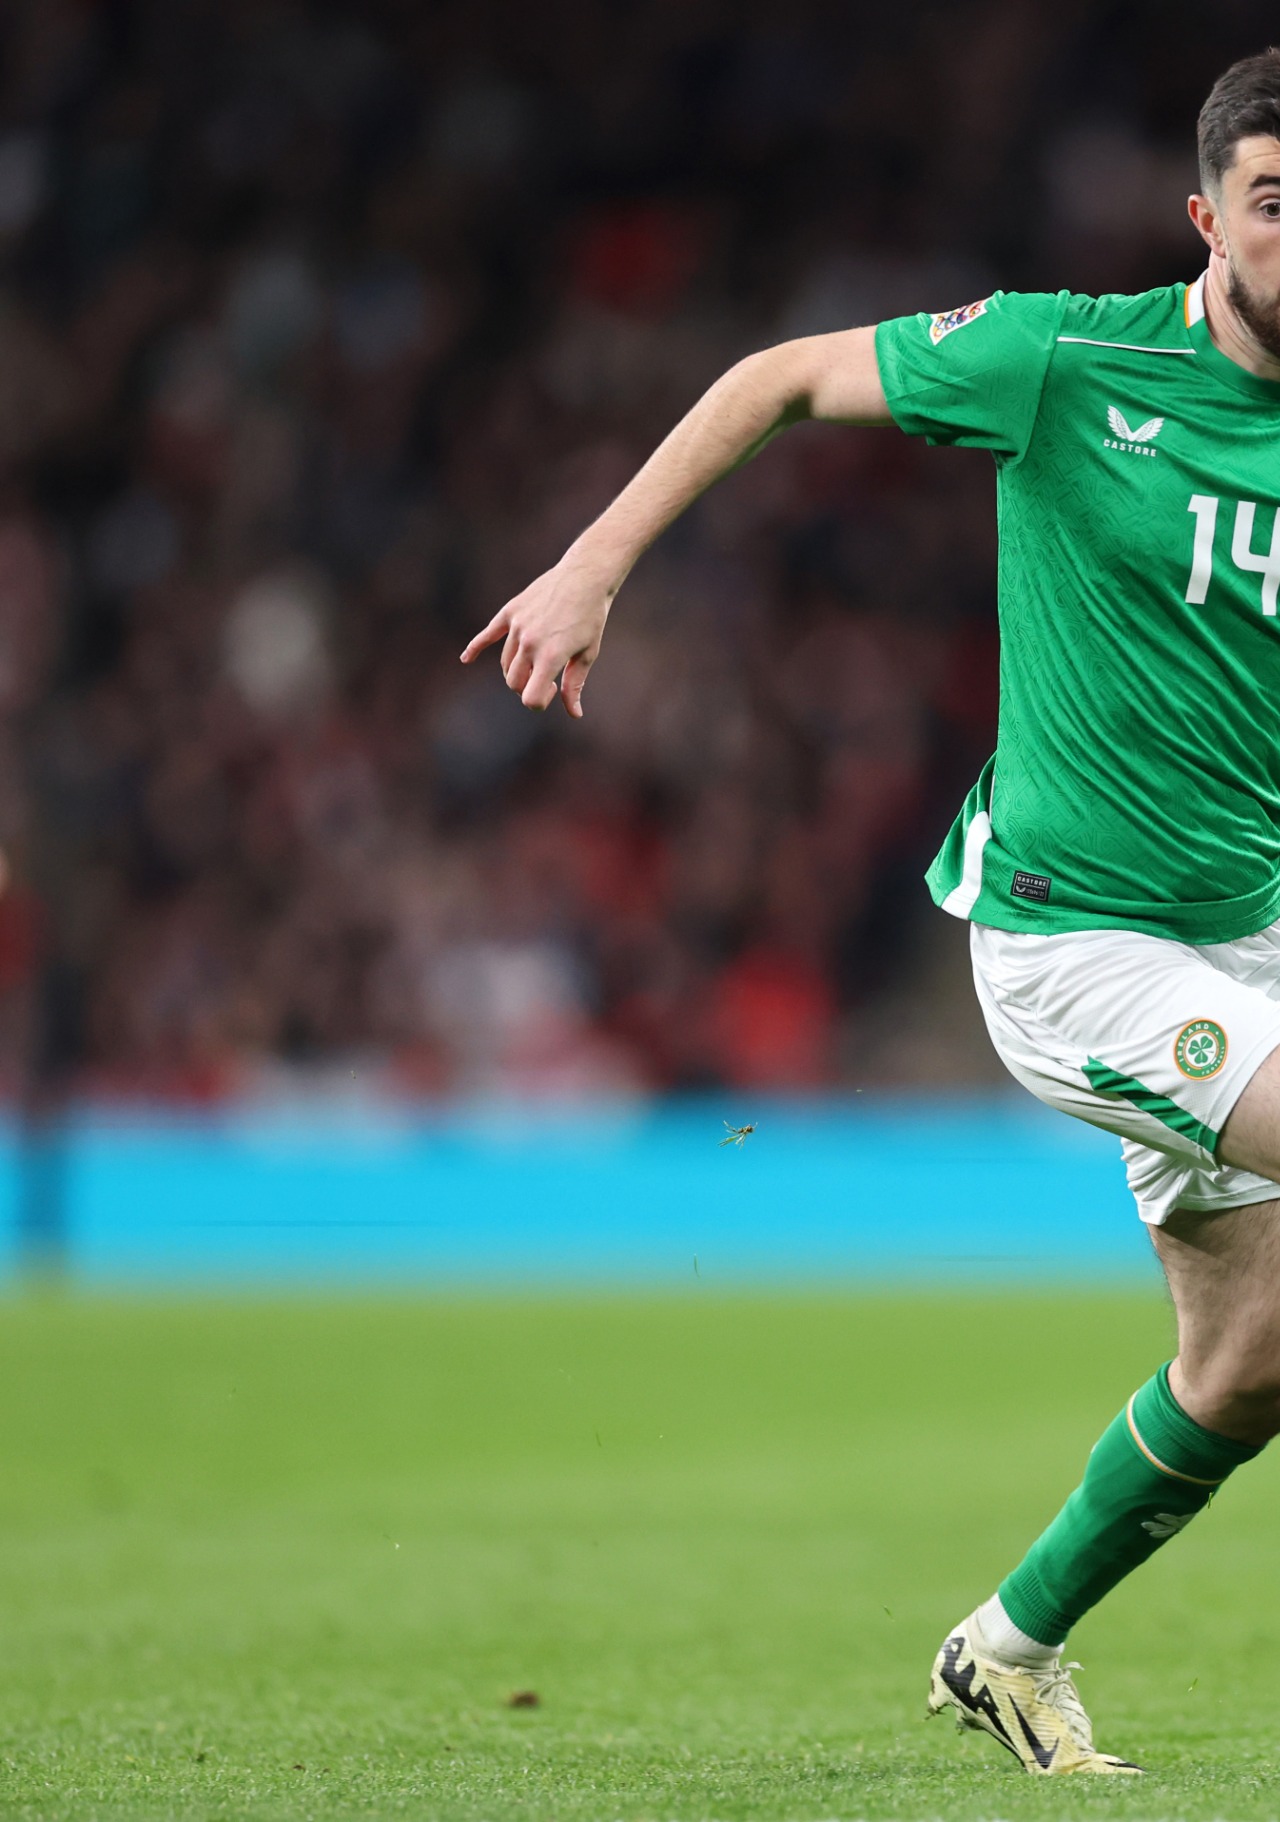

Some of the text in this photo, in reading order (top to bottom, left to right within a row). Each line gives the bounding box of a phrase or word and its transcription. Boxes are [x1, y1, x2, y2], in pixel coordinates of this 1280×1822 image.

[1103, 438, 1157, 457] CASTORE
[1017, 876, 1047, 887] CASTORE
[1177, 1023, 1209, 1063] IRELAND
